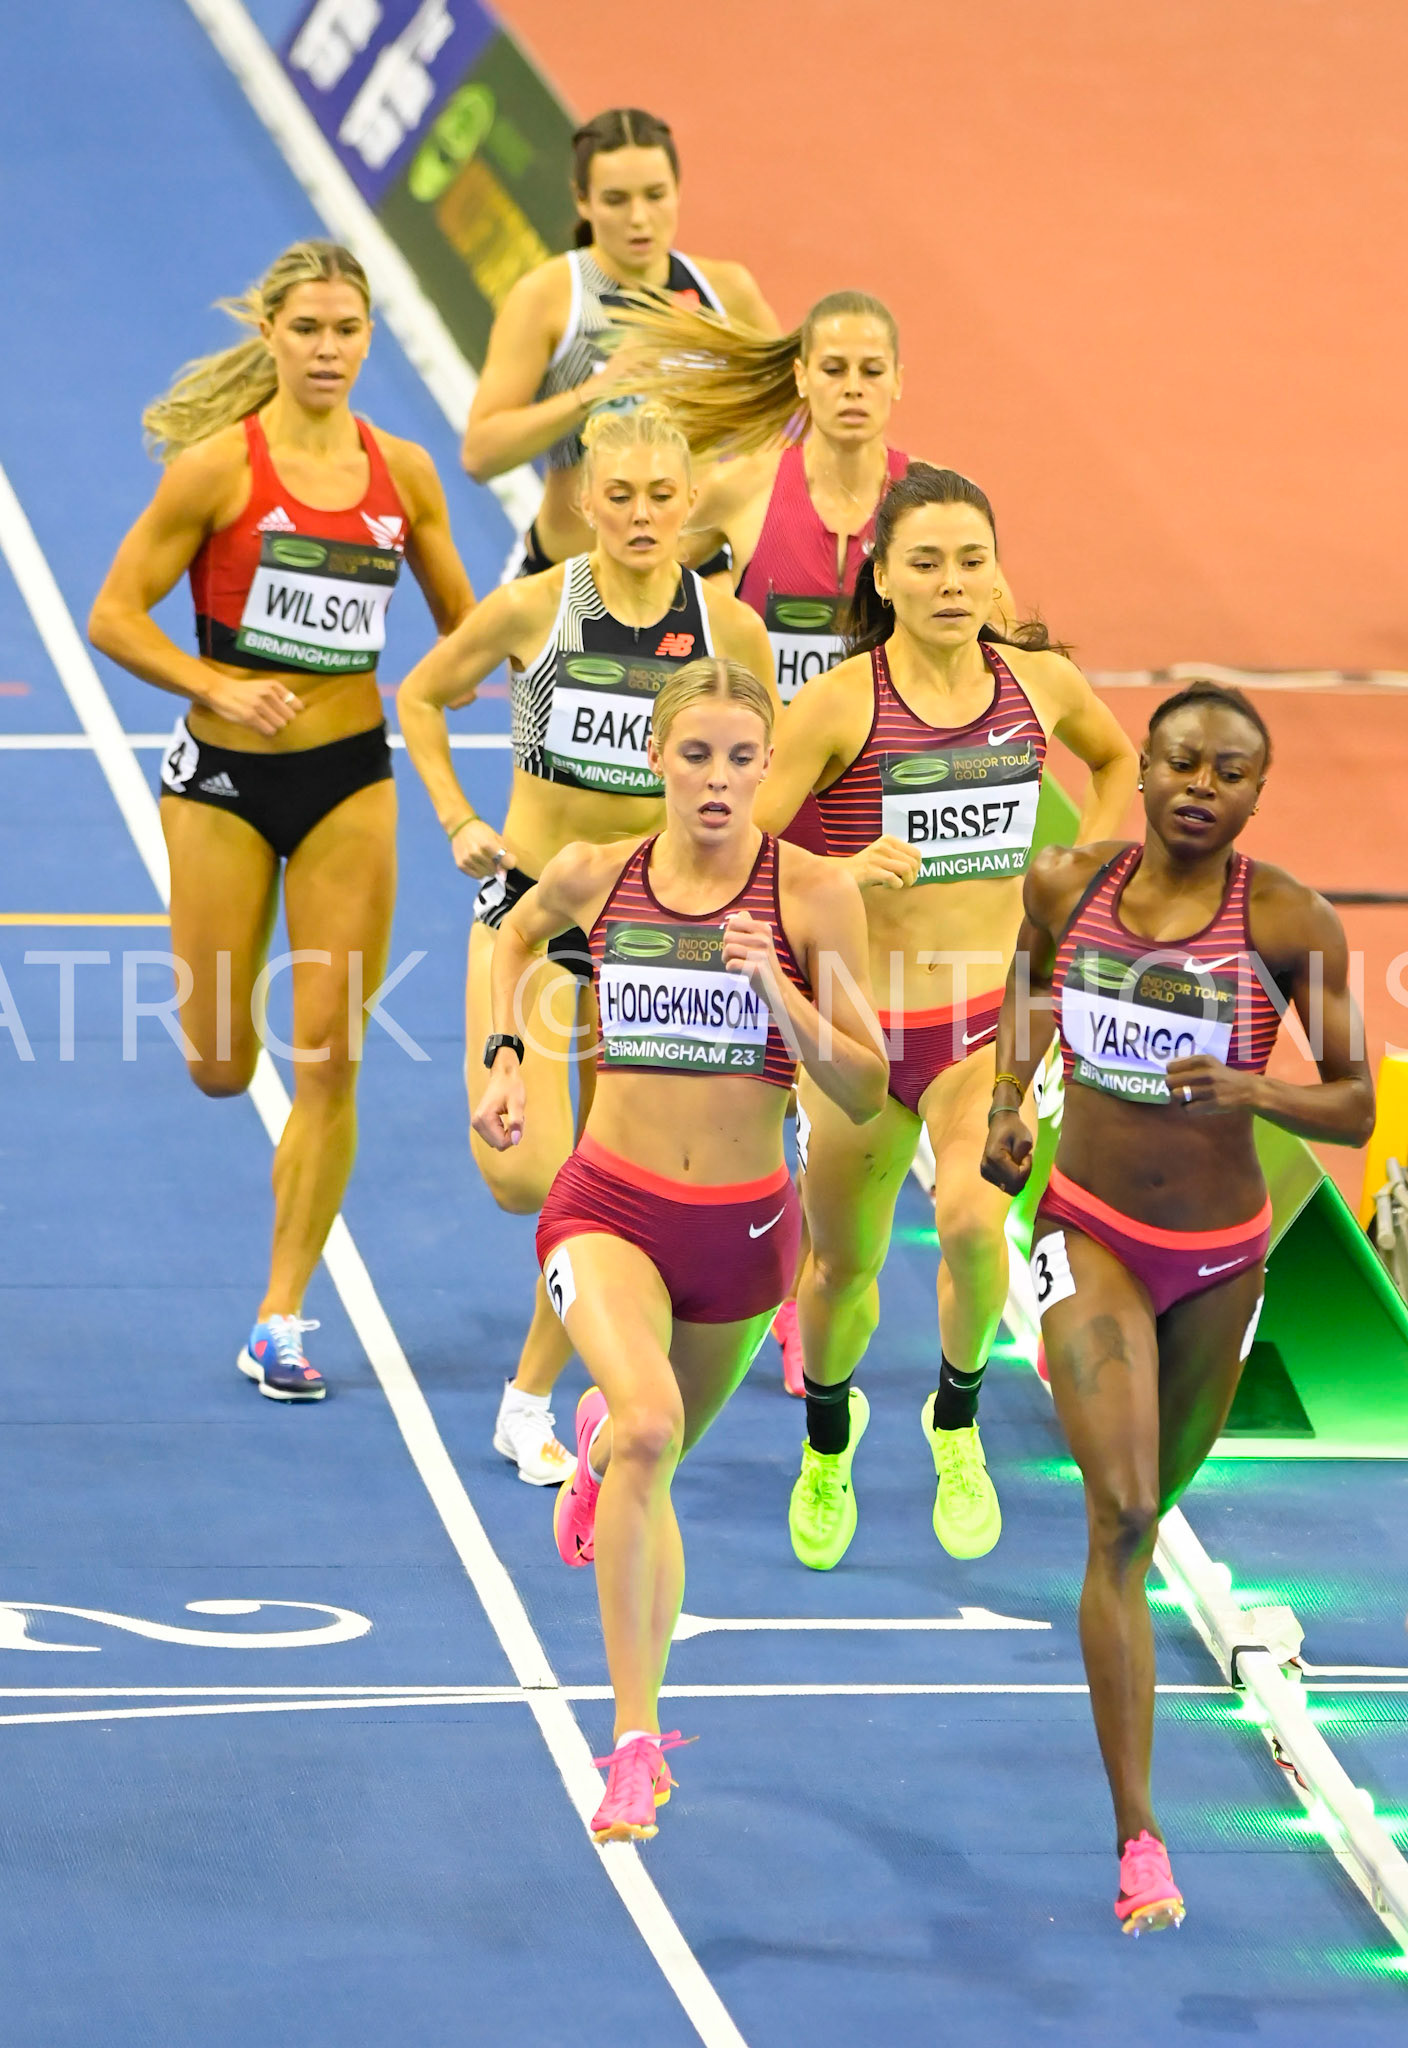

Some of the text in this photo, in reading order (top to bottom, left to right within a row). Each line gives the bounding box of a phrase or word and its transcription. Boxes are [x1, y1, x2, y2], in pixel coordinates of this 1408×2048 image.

[266, 583, 376, 634] WILSON
[953, 757, 999, 770] INDOOR
[1001, 753, 1030, 766] TOUR
[954, 768, 988, 781] GOLD
[907, 800, 1020, 844] BISSET
[917, 853, 1010, 878] MINGHAM
[676, 949, 712, 962] GOLD
[1139, 985, 1176, 1004] GOLD
[1140, 974, 1191, 995] INDOOR
[607, 982, 759, 1031] HODGKINSON
[1089, 1010, 1196, 1061] YARIGO
[608, 1040, 756, 1065] BIRMINGHAM 23
[1080, 1059, 1171, 1097] BIRMINGHA
[1036, 1252, 1054, 1302] 3
